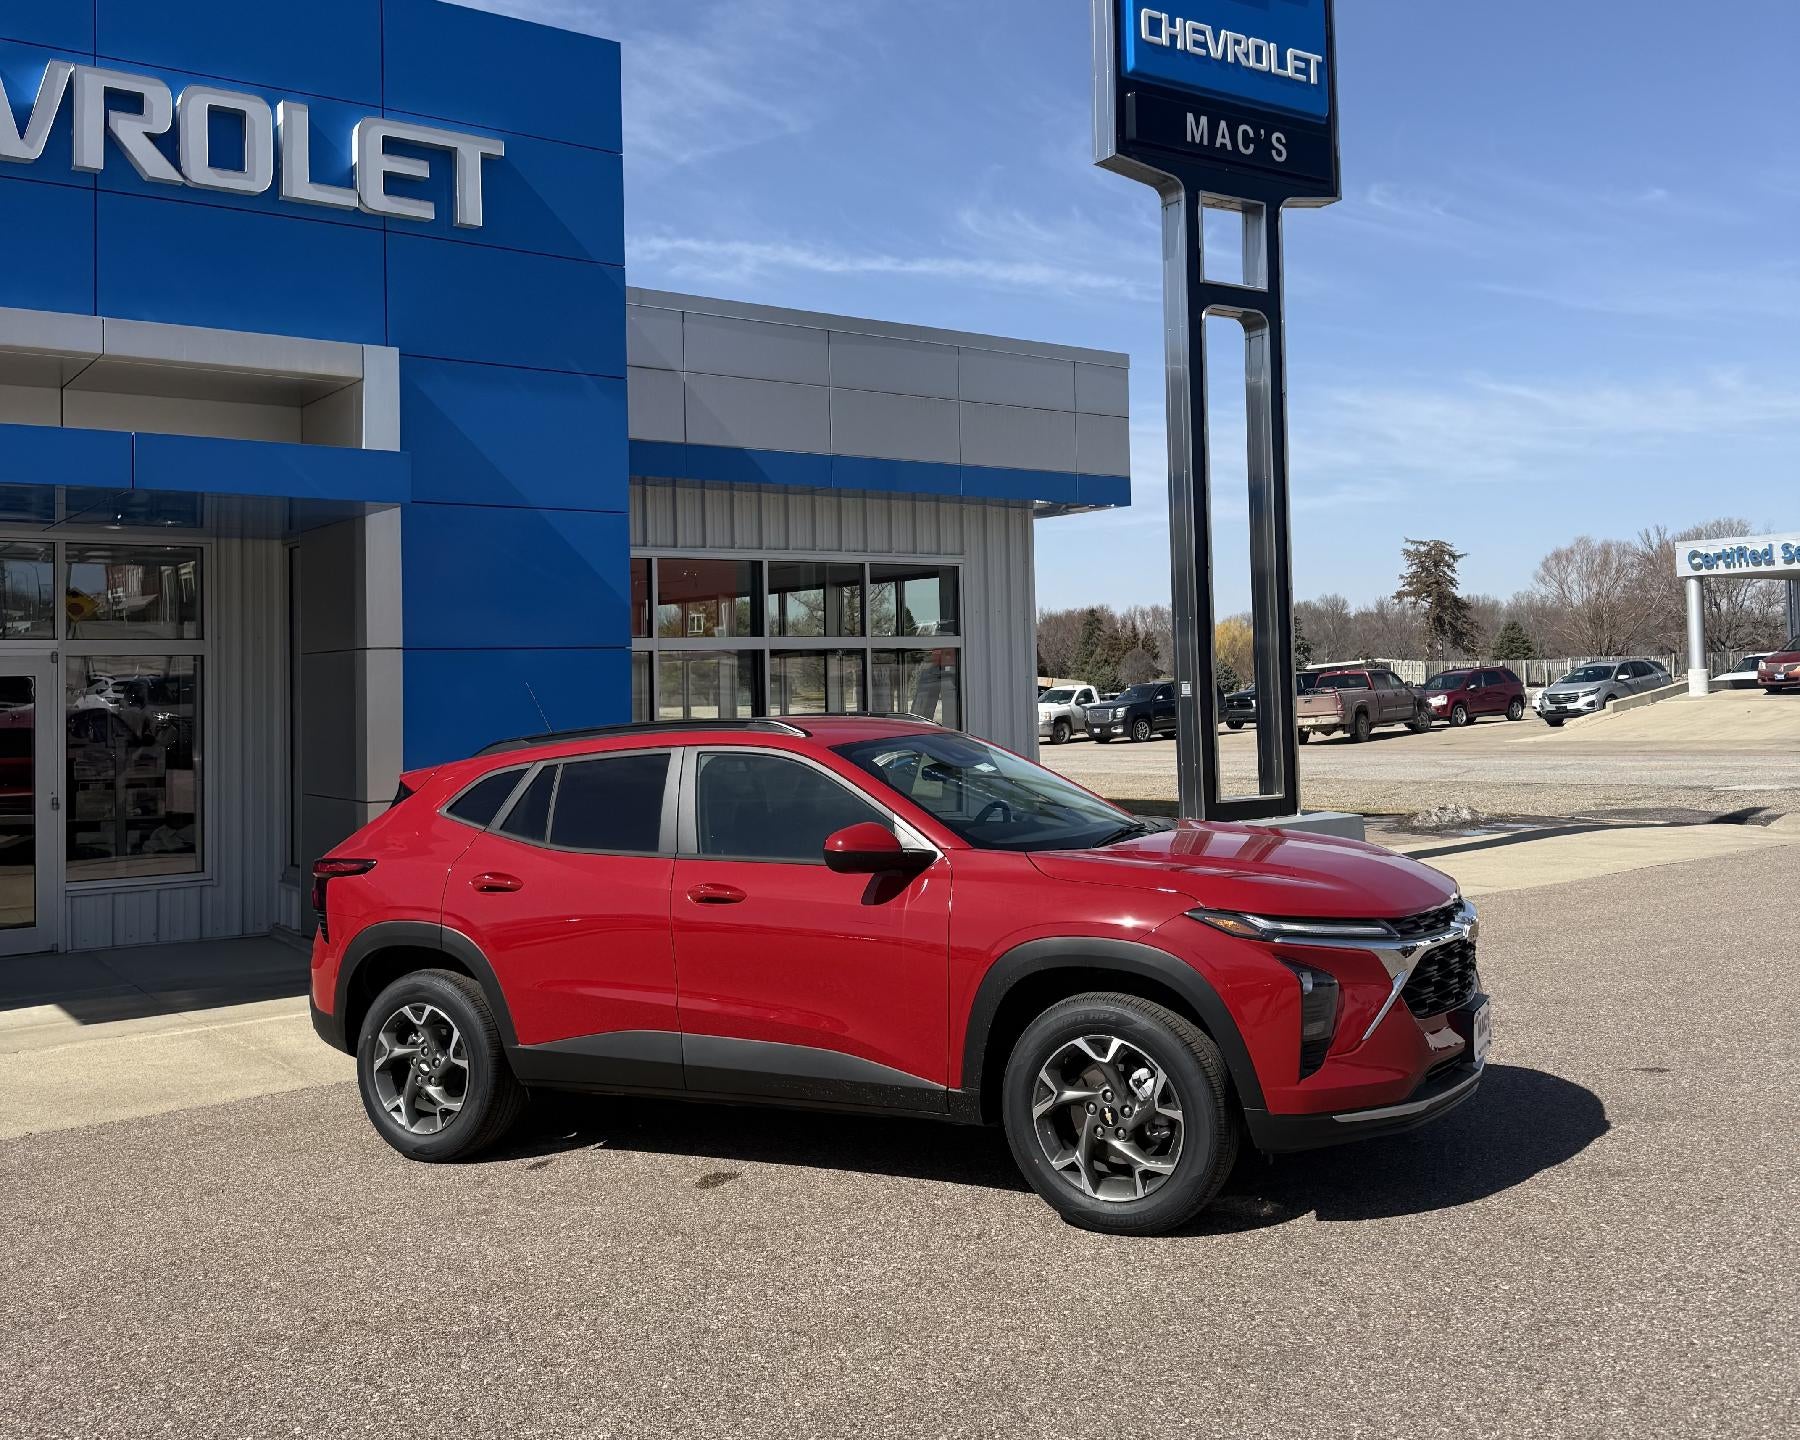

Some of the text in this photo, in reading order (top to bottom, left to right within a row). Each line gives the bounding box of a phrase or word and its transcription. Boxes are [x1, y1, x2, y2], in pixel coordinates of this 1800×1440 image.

[1140, 7, 1323, 85] CHEVROLET
[1185, 112, 1288, 163] MAC'S
[1687, 543, 1774, 569] Certified
